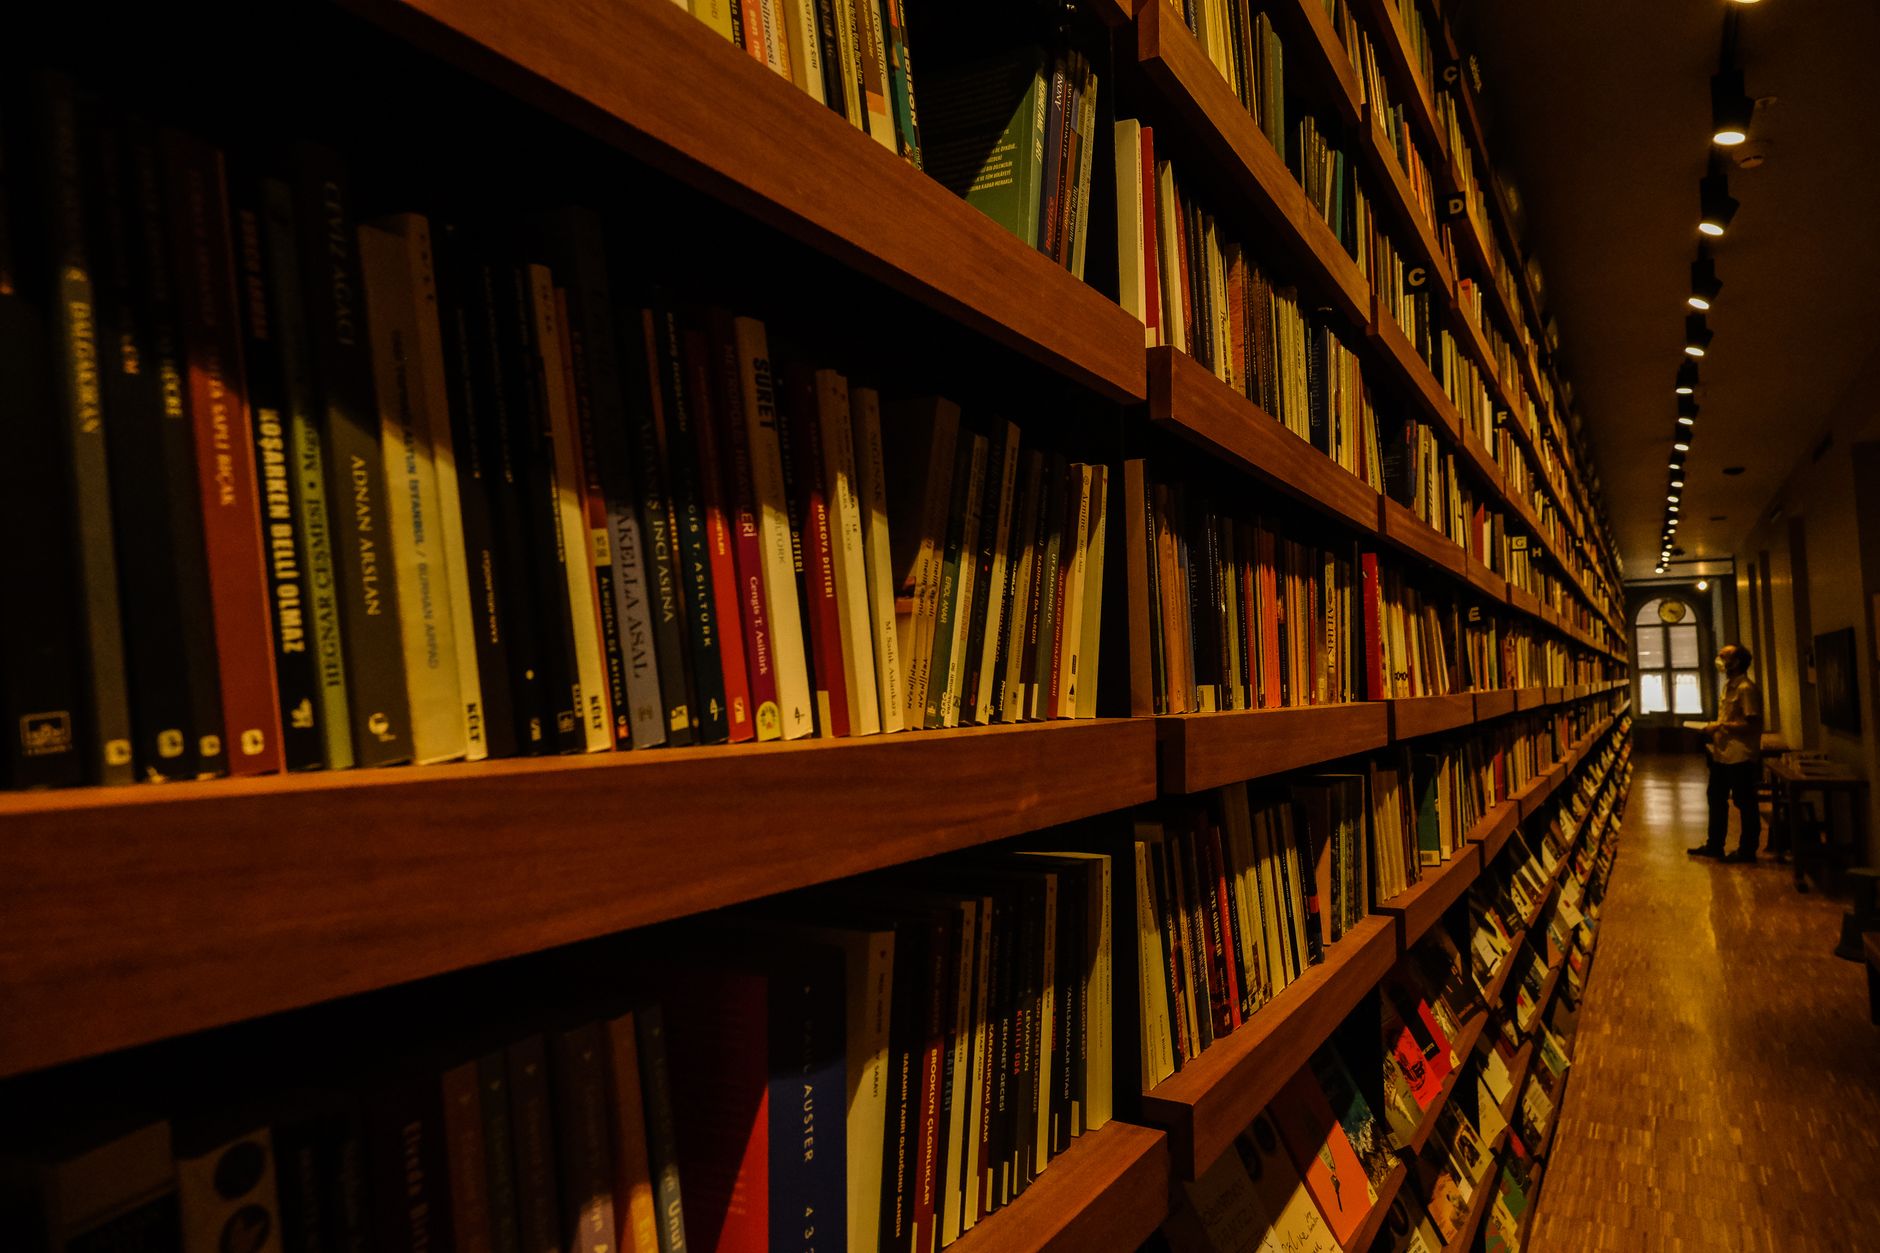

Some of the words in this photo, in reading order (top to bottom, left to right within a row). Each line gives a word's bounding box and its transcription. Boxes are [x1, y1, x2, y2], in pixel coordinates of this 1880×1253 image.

[1449, 198, 1464, 214] D
[1407, 267, 1426, 287] C
[751, 357, 777, 433] SURET
[1496, 411, 1508, 424] F
[256, 409, 291, 519] KOŞARKEN
[350, 455, 374, 533] ADNAN
[269, 524, 300, 580] BELLİ
[815, 504, 829, 554] MOSKOVA
[790, 531, 804, 574] DEFTERİ
[358, 539, 381, 617] ARSLAN
[655, 566, 676, 624] ASENA
[748, 576, 762, 615] Cengis
[820, 556, 834, 600] DEFTERİ
[943, 576, 952, 599] EROL
[1033, 554, 1042, 598] KADINLAR
[1047, 566, 1055, 612] KARADENİZ
[276, 584, 305, 654] OLMAZ
[939, 599, 950, 625] ANAR
[1468, 606, 1481, 622] E
[626, 616, 649, 680] ASAL
[754, 631, 770, 677] Asiltürk
[588, 695, 603, 732] KÜLT
[999, 1018, 1009, 1071] KEHANET
[1023, 1009, 1032, 1073] LEVIATHAN
[1064, 985, 1073, 1065] YANILSAMALAR
[899, 1053, 909, 1101] BABAMIN
[927, 1048, 938, 1116] BROOKLYN
[983, 1023, 994, 1106] KARANLIKTAKİ
[1012, 1052, 1022, 1076] ODA
[1062, 1066, 1071, 1101] KİTABI
[998, 1072, 1007, 1113] GECESİ
[802, 1084, 815, 1164] AUSTER
[898, 1103, 907, 1134] TANRI
[981, 1107, 991, 1144] ADAM
[896, 1136, 905, 1194] OLDUĞUNU
[922, 1117, 935, 1206] ÇILGINLIKLARI
[894, 1195, 903, 1239] SANDIM
